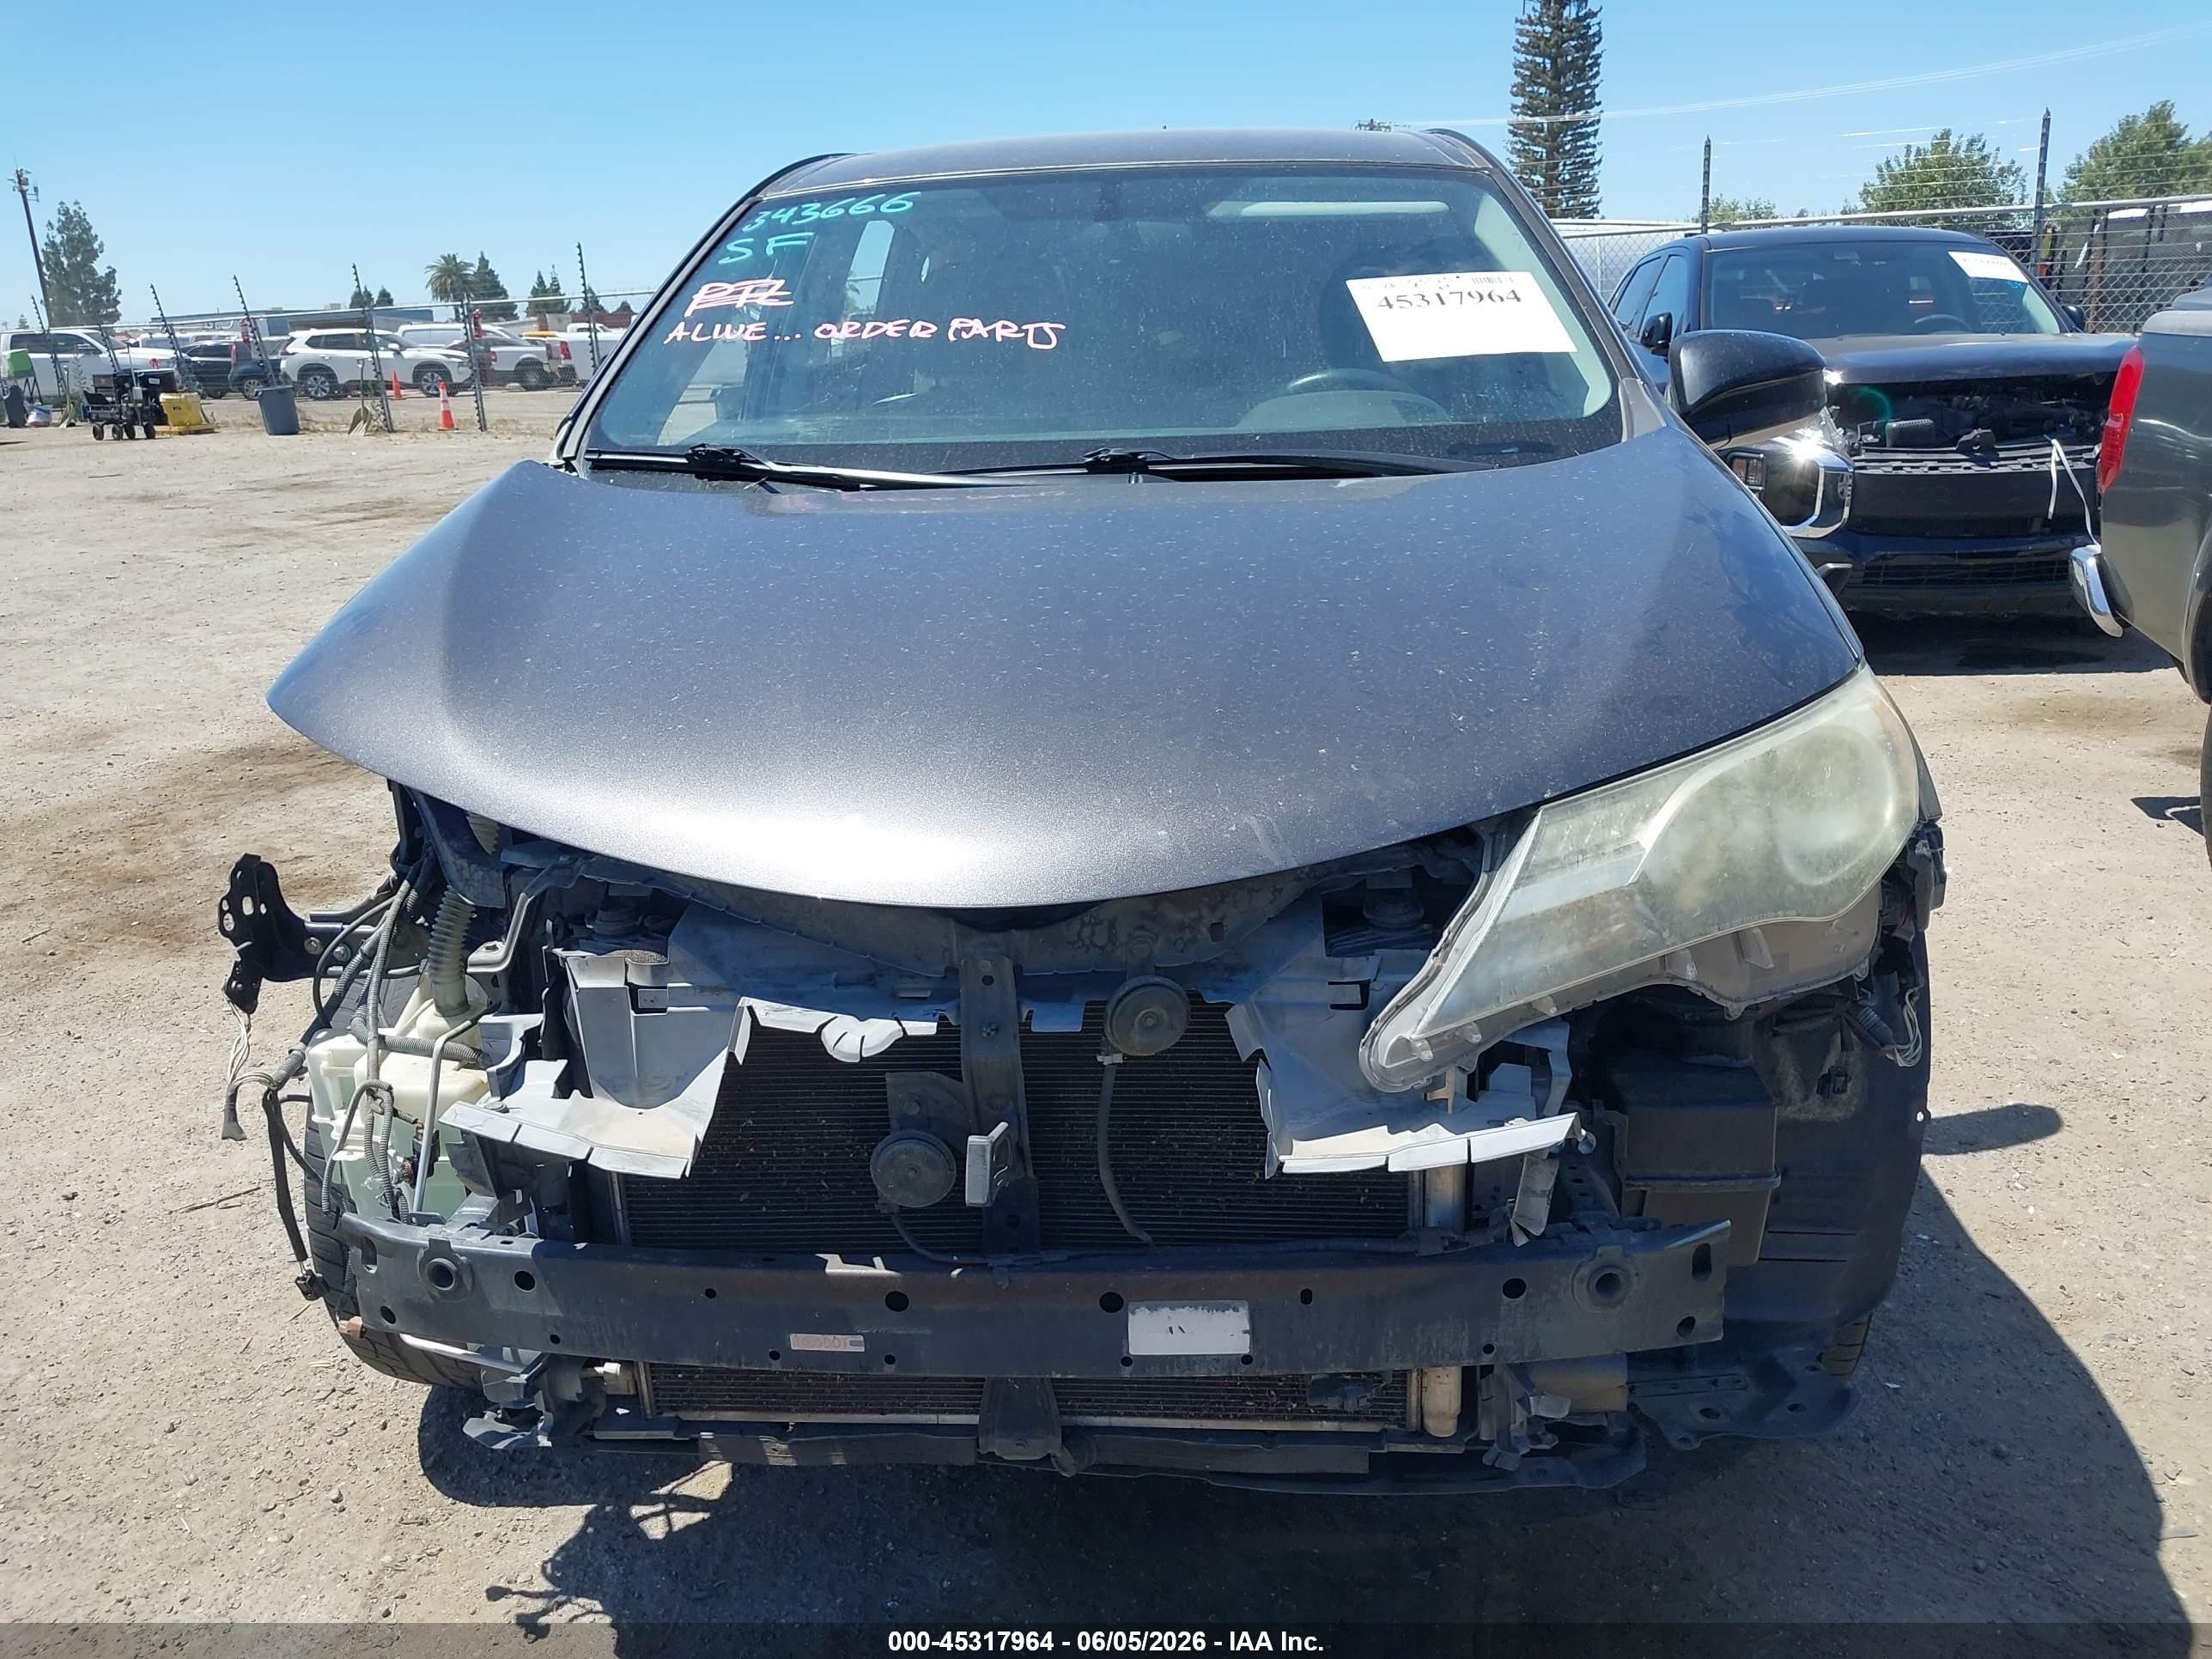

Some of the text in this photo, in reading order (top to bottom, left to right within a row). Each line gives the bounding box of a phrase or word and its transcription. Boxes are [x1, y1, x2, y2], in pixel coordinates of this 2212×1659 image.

[742, 191, 921, 232] 343666
[1377, 289, 1522, 310] 45317964
[813, 319, 939, 339] ORDER
[947, 318, 1066, 349] PARTS
